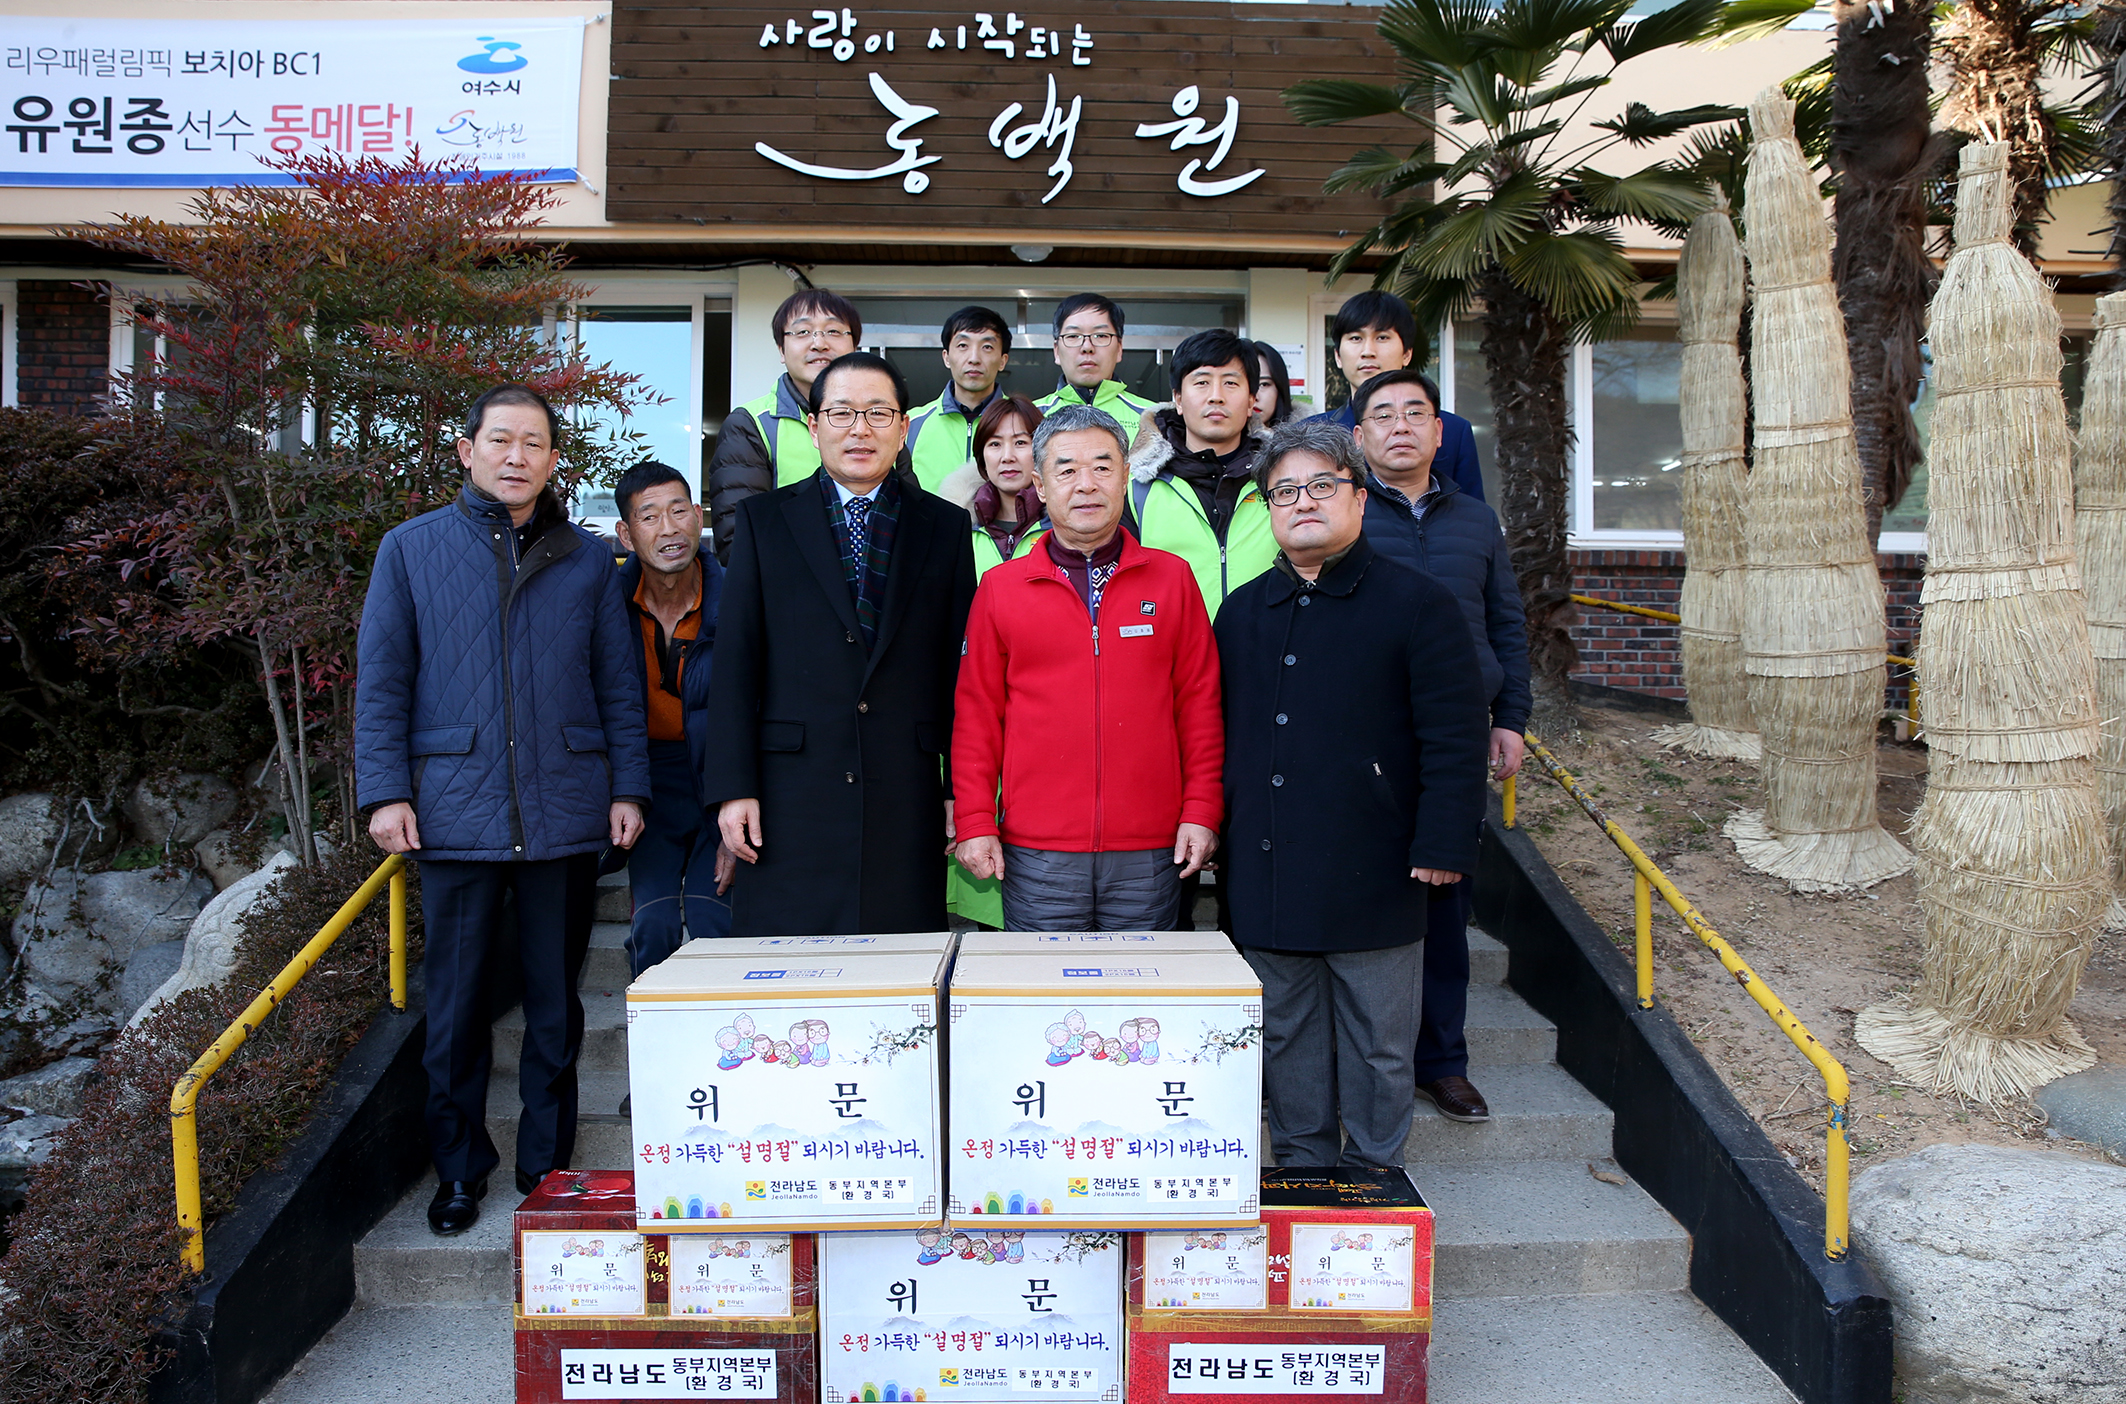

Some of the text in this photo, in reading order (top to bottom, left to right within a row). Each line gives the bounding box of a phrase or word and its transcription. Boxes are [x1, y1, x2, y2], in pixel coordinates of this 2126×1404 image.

[759, 9, 1094, 66] 사랑이 시작되는
[6, 47, 321, 79] 리우패럴림픽 보치아 BC1
[461, 79, 521, 95] 여수시
[5, 95, 413, 155] 유원종 선수 동메달!
[754, 72, 1266, 204] 동백원
[686, 1081, 868, 1122] 위 문
[1011, 1078, 1195, 1119] 위 문
[639, 1143, 670, 1164] 온정
[675, 1142, 724, 1164] 가득한
[802, 1140, 849, 1160] 되시기
[854, 1138, 925, 1160] 바랍니다.
[961, 1138, 993, 1160] 온정
[998, 1138, 1048, 1160] 가득한
[1126, 1138, 1174, 1159] 되시기
[1179, 1138, 1248, 1159] 바랍니다.
[770, 1180, 818, 1193] 전라남도
[1092, 1177, 1140, 1191] 전라남도
[1093, 1190, 1140, 1198] JeollaNamdo
[550, 1262, 618, 1277] 위 문
[696, 1263, 764, 1278] 위 문
[1172, 1255, 1240, 1270] 위 문
[1318, 1255, 1386, 1271] 위 문
[886, 1278, 1057, 1315] 위 문
[838, 1333, 869, 1352] 온정
[873, 1332, 920, 1351] 가득한
[994, 1331, 1039, 1351] 되시기
[1043, 1331, 1110, 1351] 바랍니다.
[672, 1357, 772, 1374] 동부지역본부
[1281, 1353, 1380, 1369] 동부지역본부
[963, 1368, 1008, 1380] 전라남도
